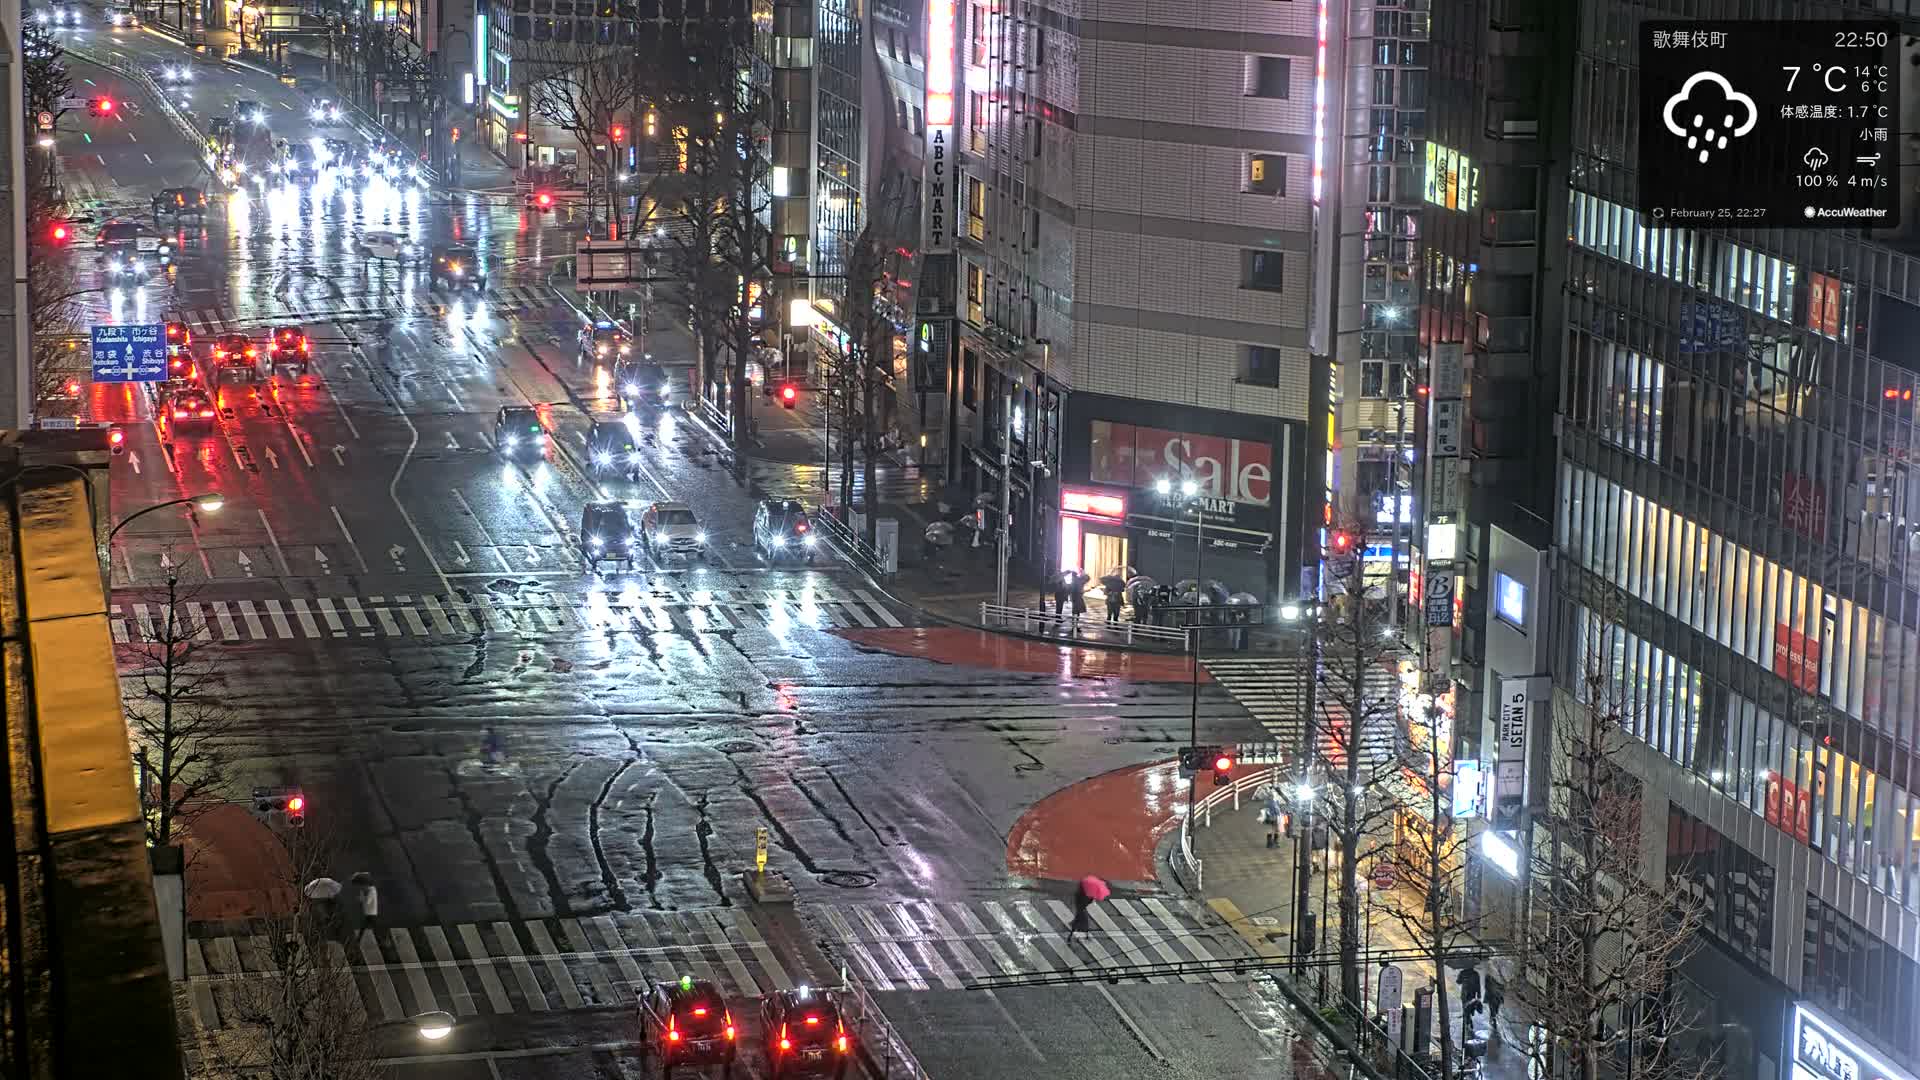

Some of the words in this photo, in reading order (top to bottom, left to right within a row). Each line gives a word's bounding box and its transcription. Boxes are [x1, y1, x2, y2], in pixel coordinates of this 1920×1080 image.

[932, 130, 944, 245] ABC-MART
[98, 327, 126, 336] 九段下
[1163, 437, 1272, 508] Sale
[1512, 692, 1525, 703] 5
[1503, 703, 1511, 722] CITY
[1502, 723, 1510, 742] PARK
[1510, 707, 1525, 749] ISETAN
